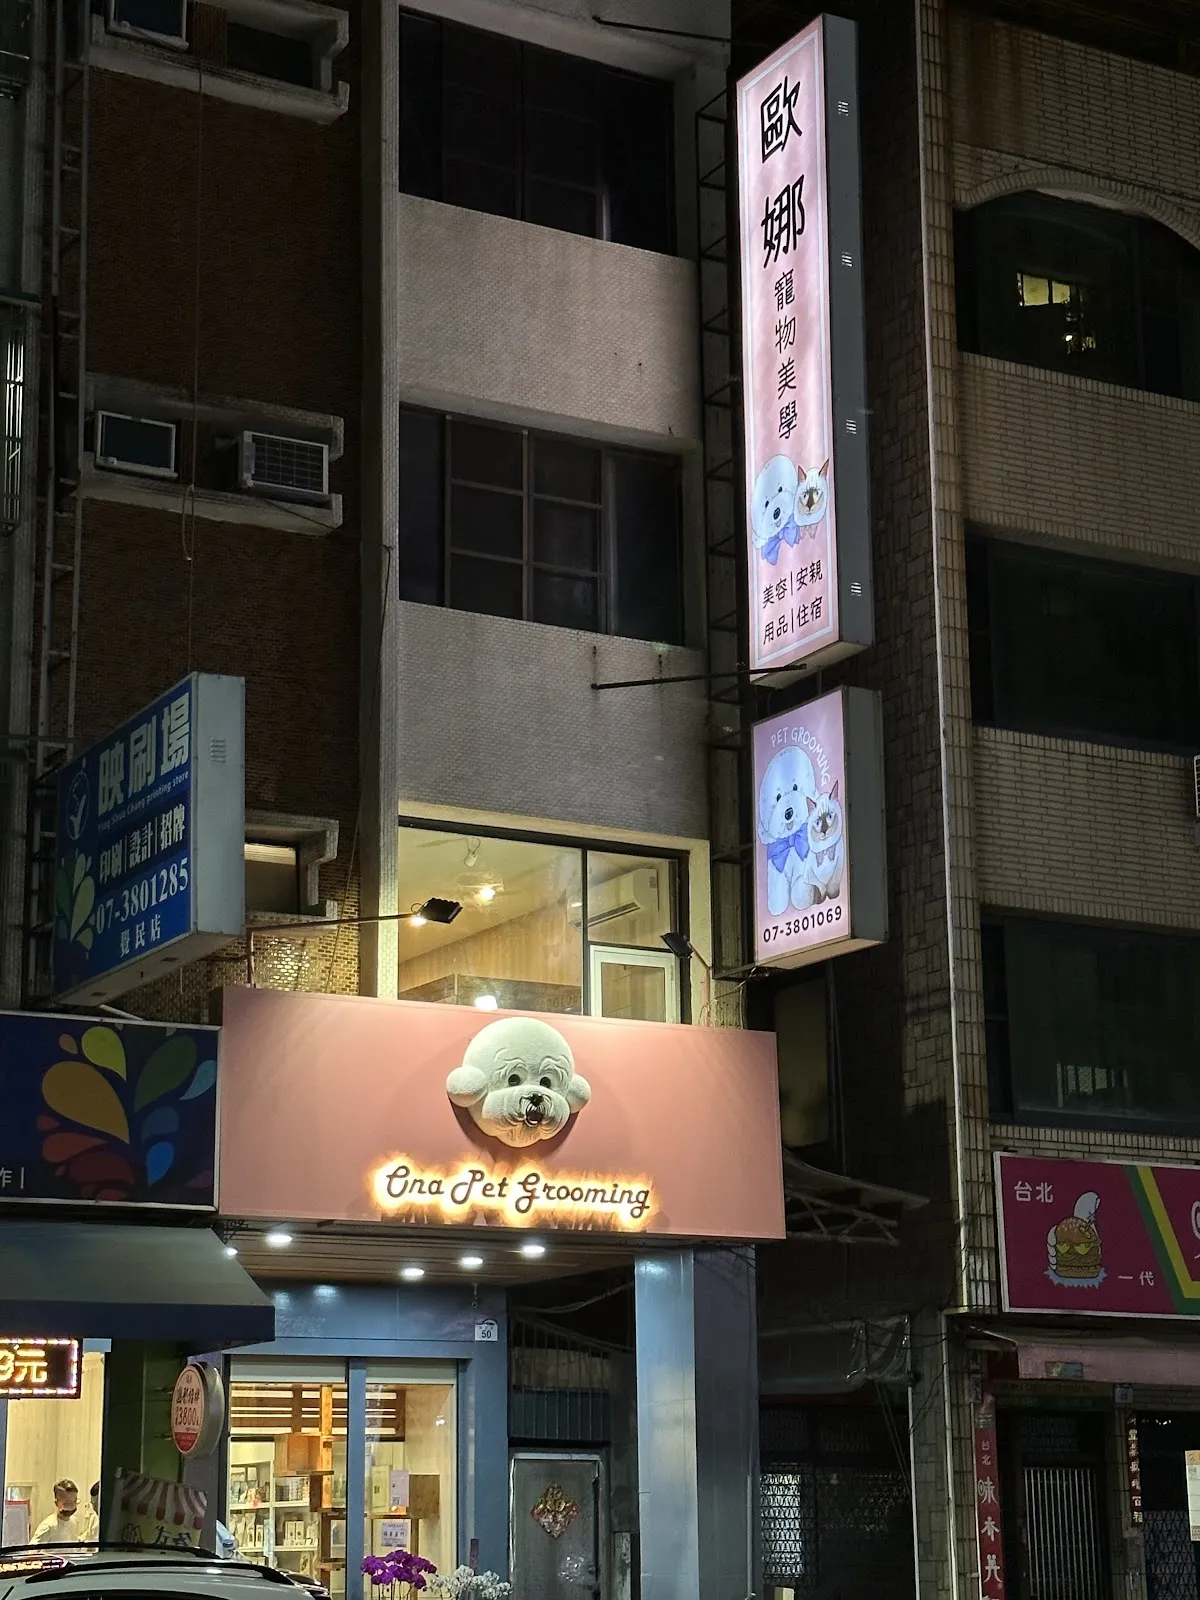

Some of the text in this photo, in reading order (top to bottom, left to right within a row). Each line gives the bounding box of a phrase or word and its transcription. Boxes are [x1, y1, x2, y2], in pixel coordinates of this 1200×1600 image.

[760, 75, 805, 269] 歐娜
[774, 268, 798, 440] 寵物美學
[98, 692, 190, 816] 映刷場
[172, 770, 189, 788] store
[771, 726, 831, 787] PET GROOMING
[96, 857, 188, 934] 07-3801285
[763, 905, 842, 943] 07-3801069
[386, 1165, 650, 1219] Ona Pet Grooming
[1014, 1180, 1054, 1203] 台北
[1118, 1270, 1155, 1286] 一代
[481, 1329, 492, 1339] 50
